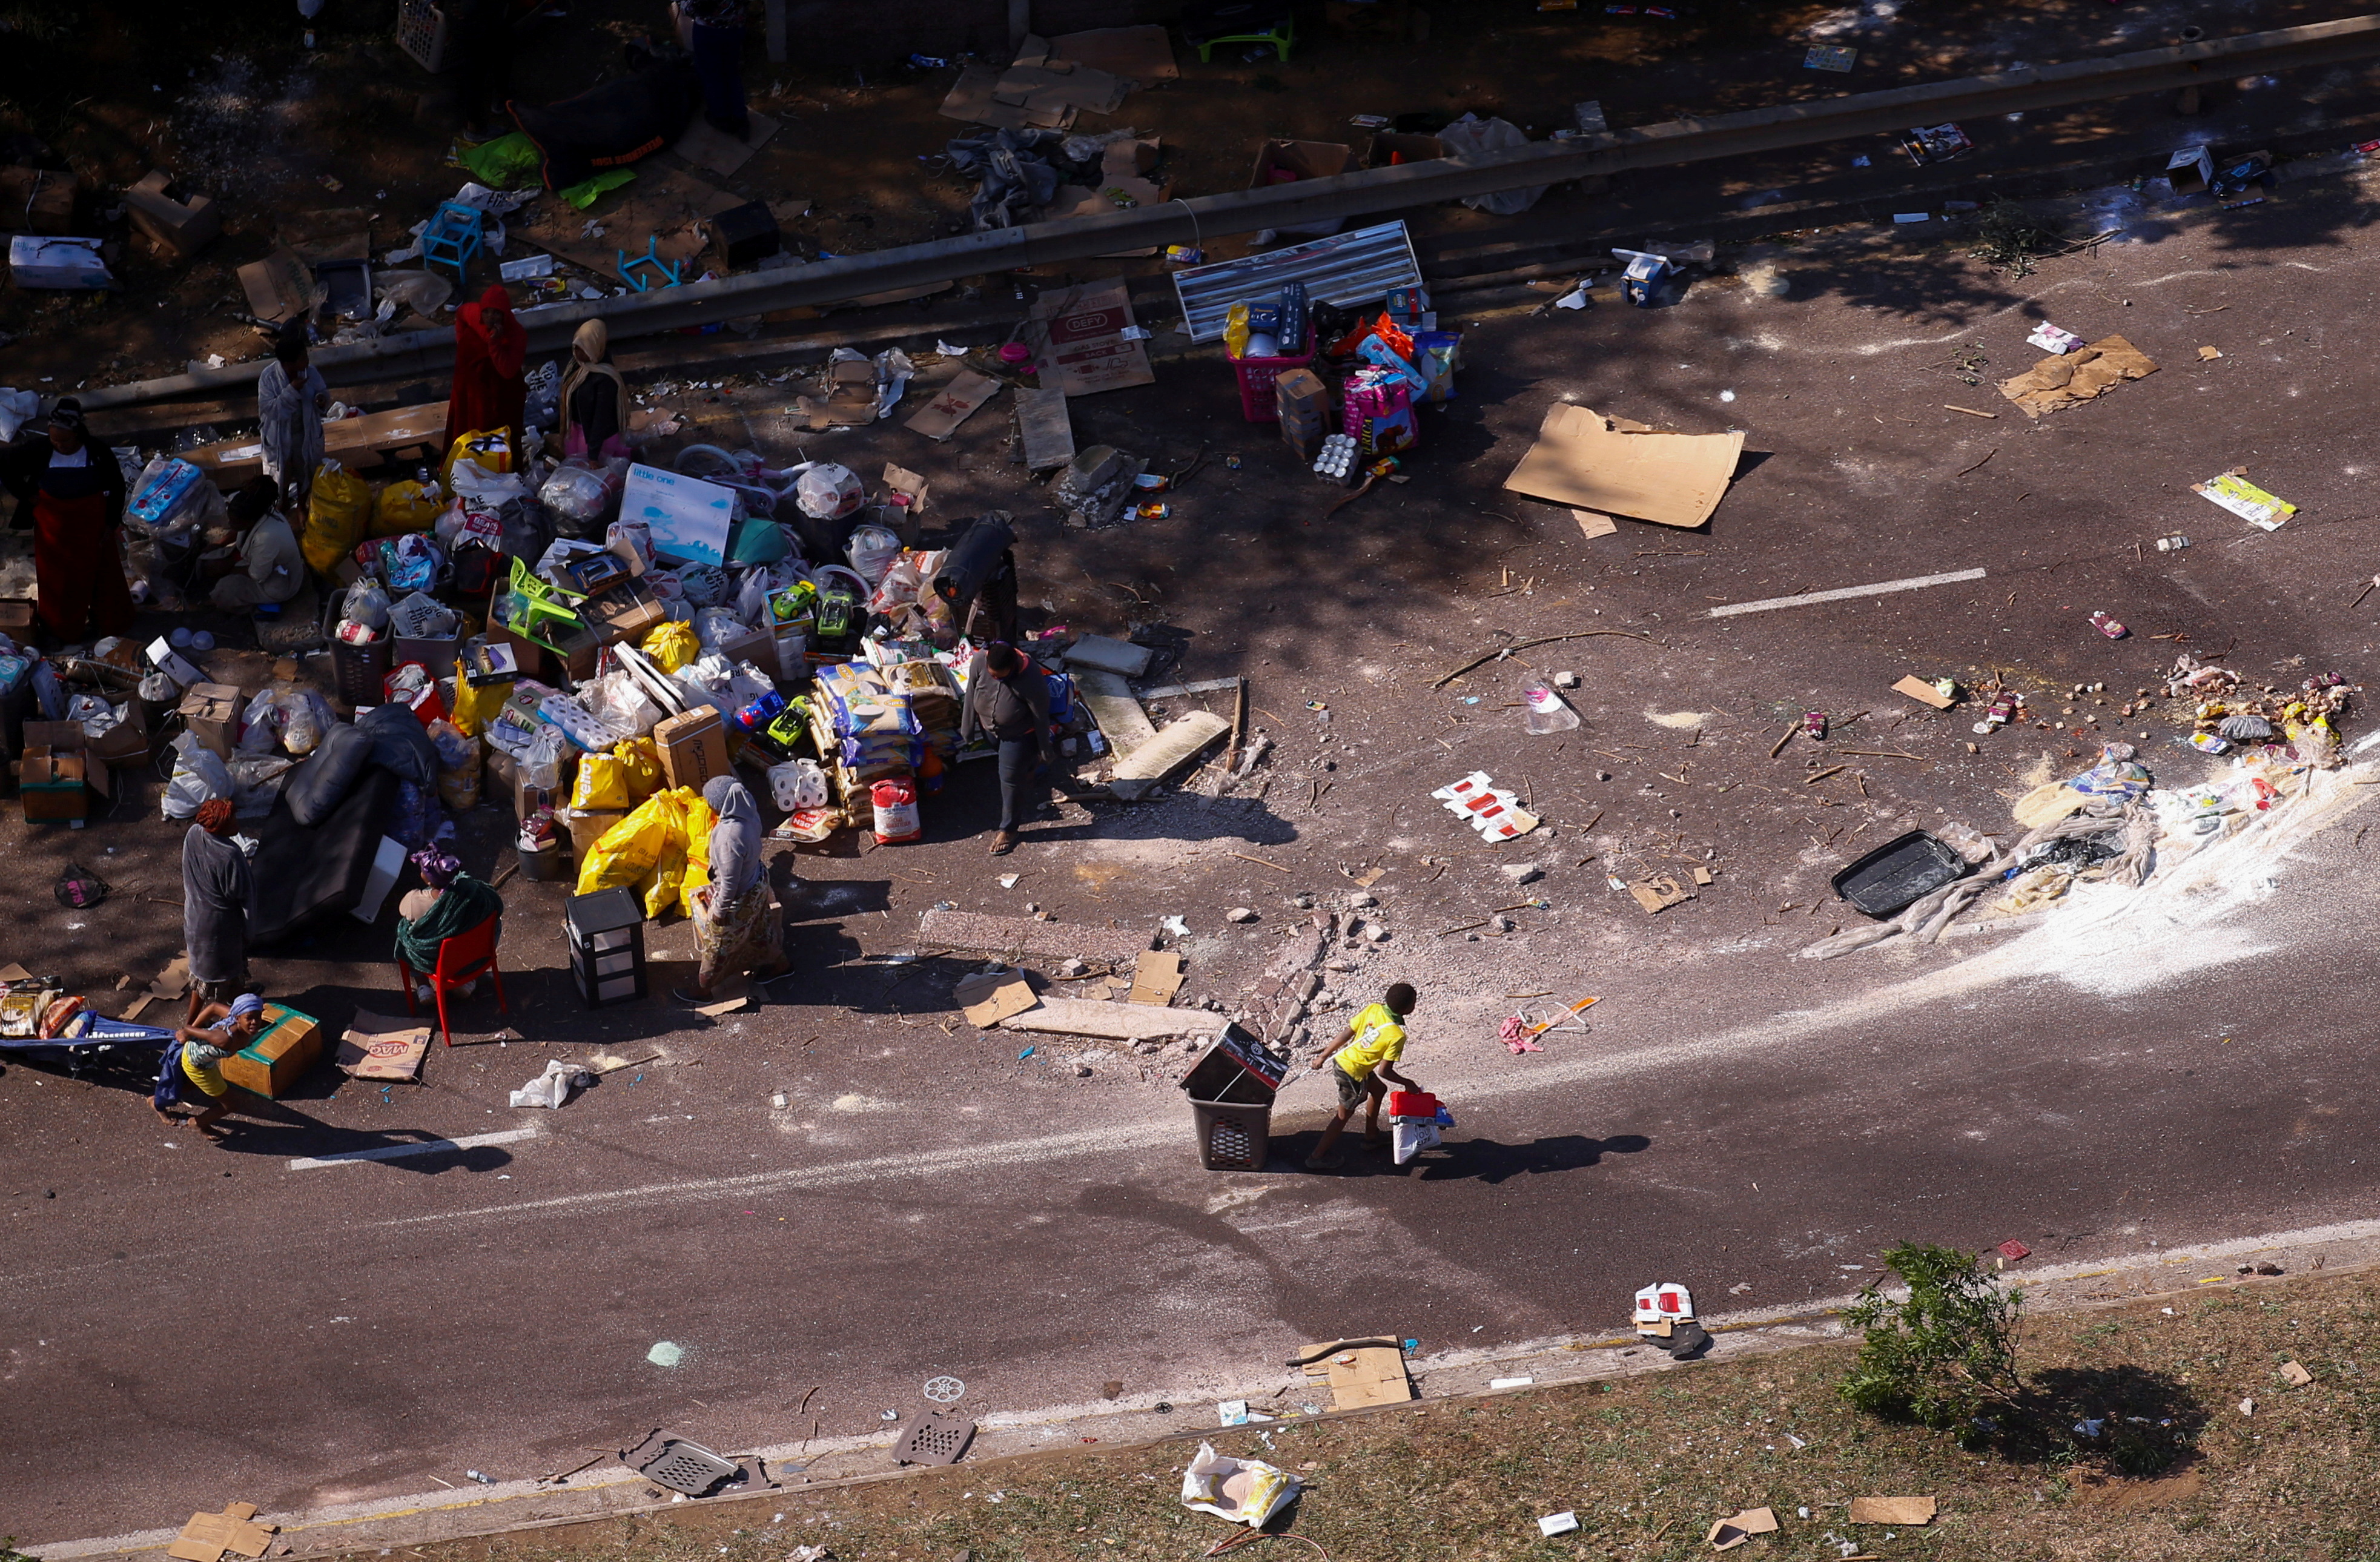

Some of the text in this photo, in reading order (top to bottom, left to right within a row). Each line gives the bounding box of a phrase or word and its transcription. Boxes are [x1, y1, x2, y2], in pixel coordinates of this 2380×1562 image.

[1072, 317, 1102, 329] DEFY
[1085, 349, 1108, 359] BACK
[633, 468, 675, 486] little one
[415, 606, 429, 624] THE
[407, 609, 425, 637] FUTUR
[369, 1044, 410, 1055] MAQ
